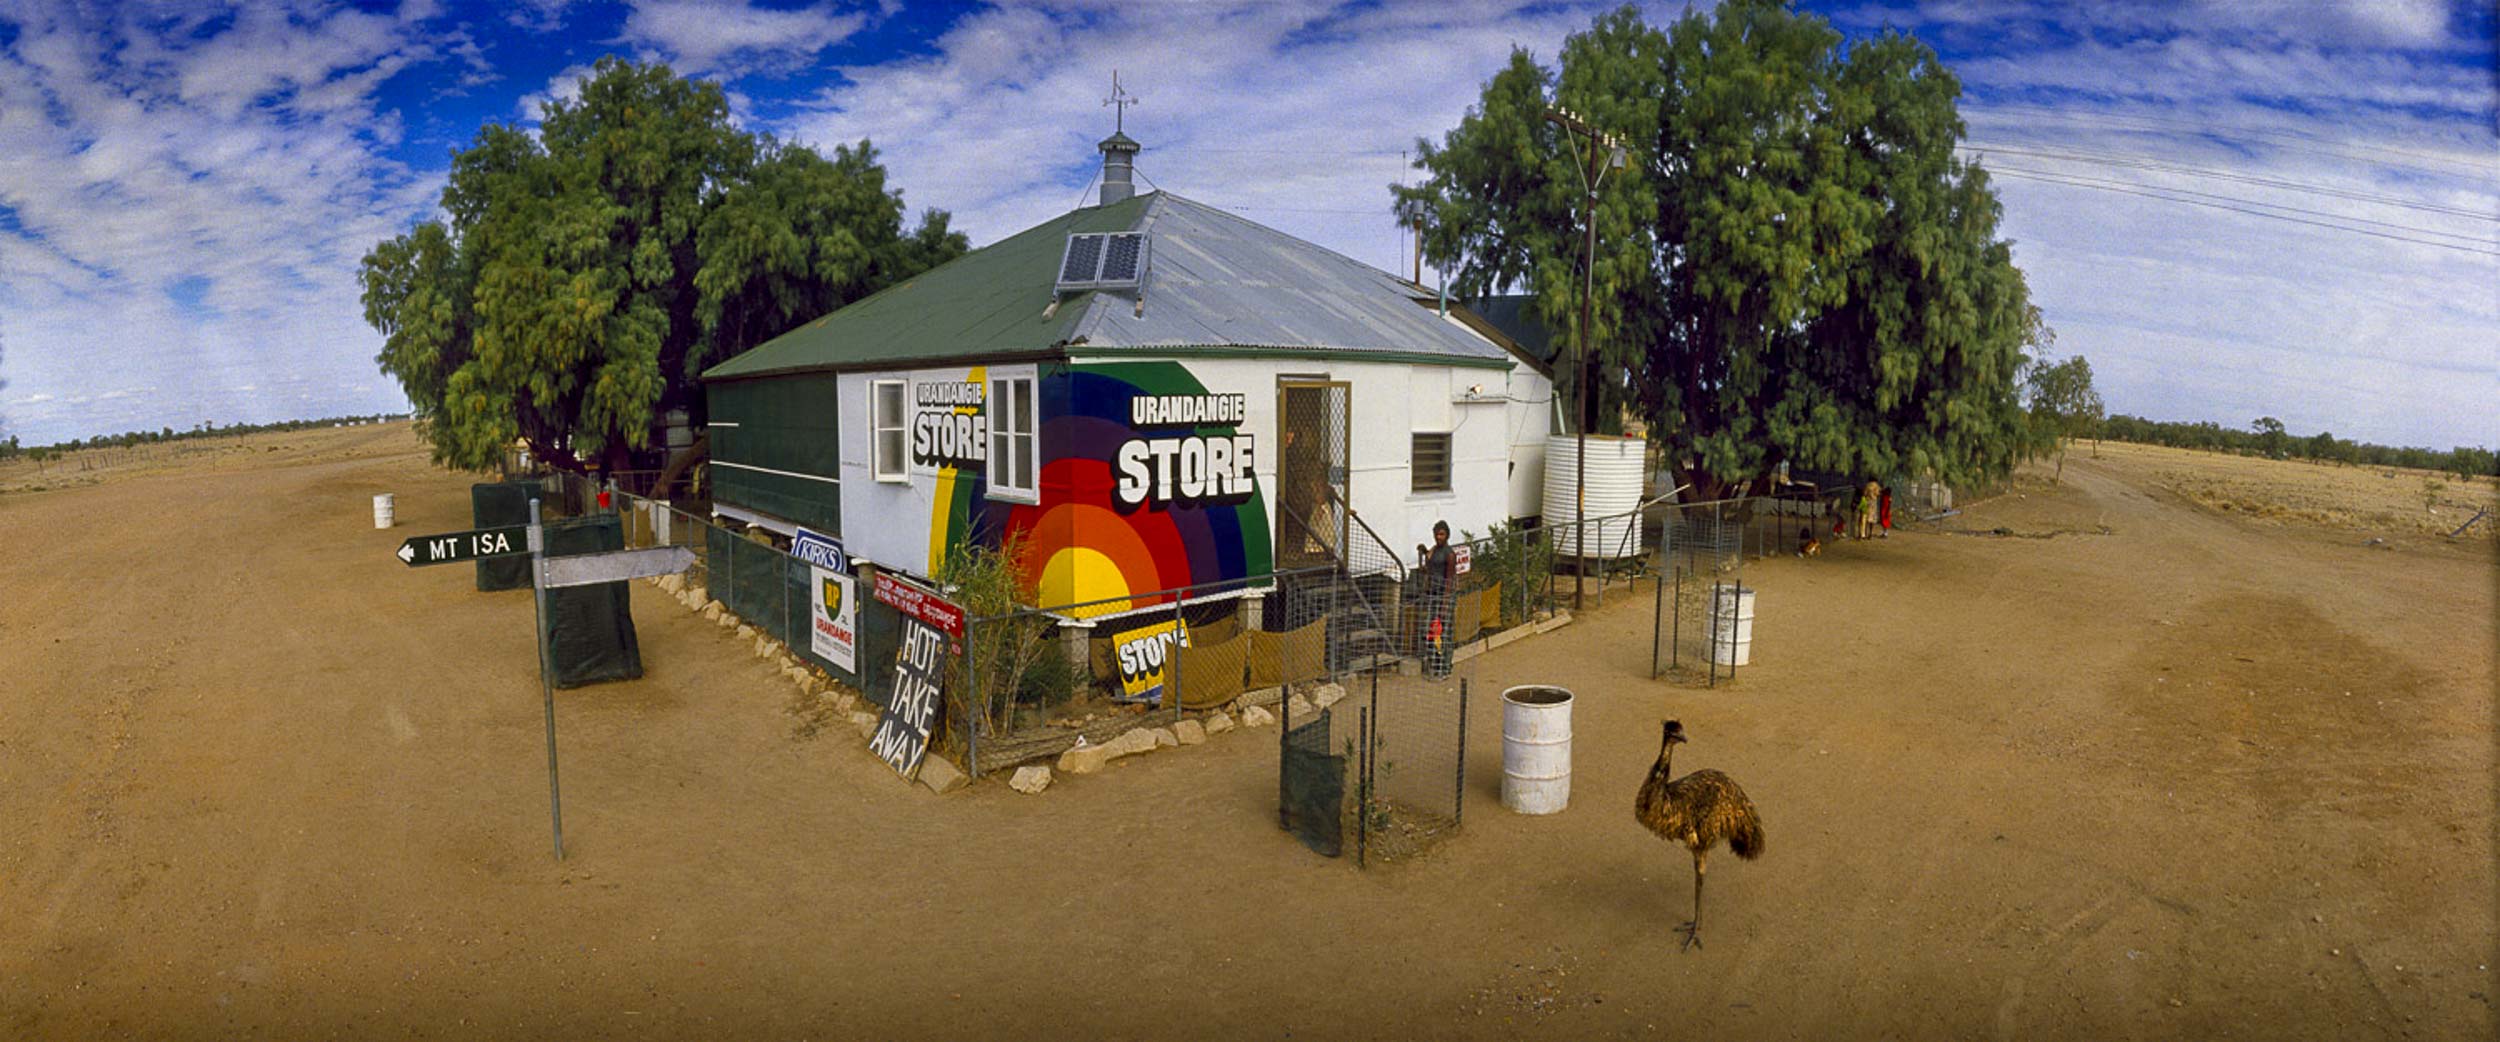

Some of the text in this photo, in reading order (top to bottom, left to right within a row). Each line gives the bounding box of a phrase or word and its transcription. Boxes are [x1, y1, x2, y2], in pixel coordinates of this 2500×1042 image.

[917, 382, 983, 406] URANDANGIE
[1131, 395, 1245, 425] URANDANGIE
[914, 412, 986, 463] STORE
[1117, 435, 1254, 504] STORE
[429, 532, 511, 561] MT ISA
[801, 541, 837, 569] KIRKS
[825, 582, 840, 609] BP
[902, 619, 940, 675] HOT
[890, 665, 939, 737] TAKE
[869, 719, 924, 776] AWAY
